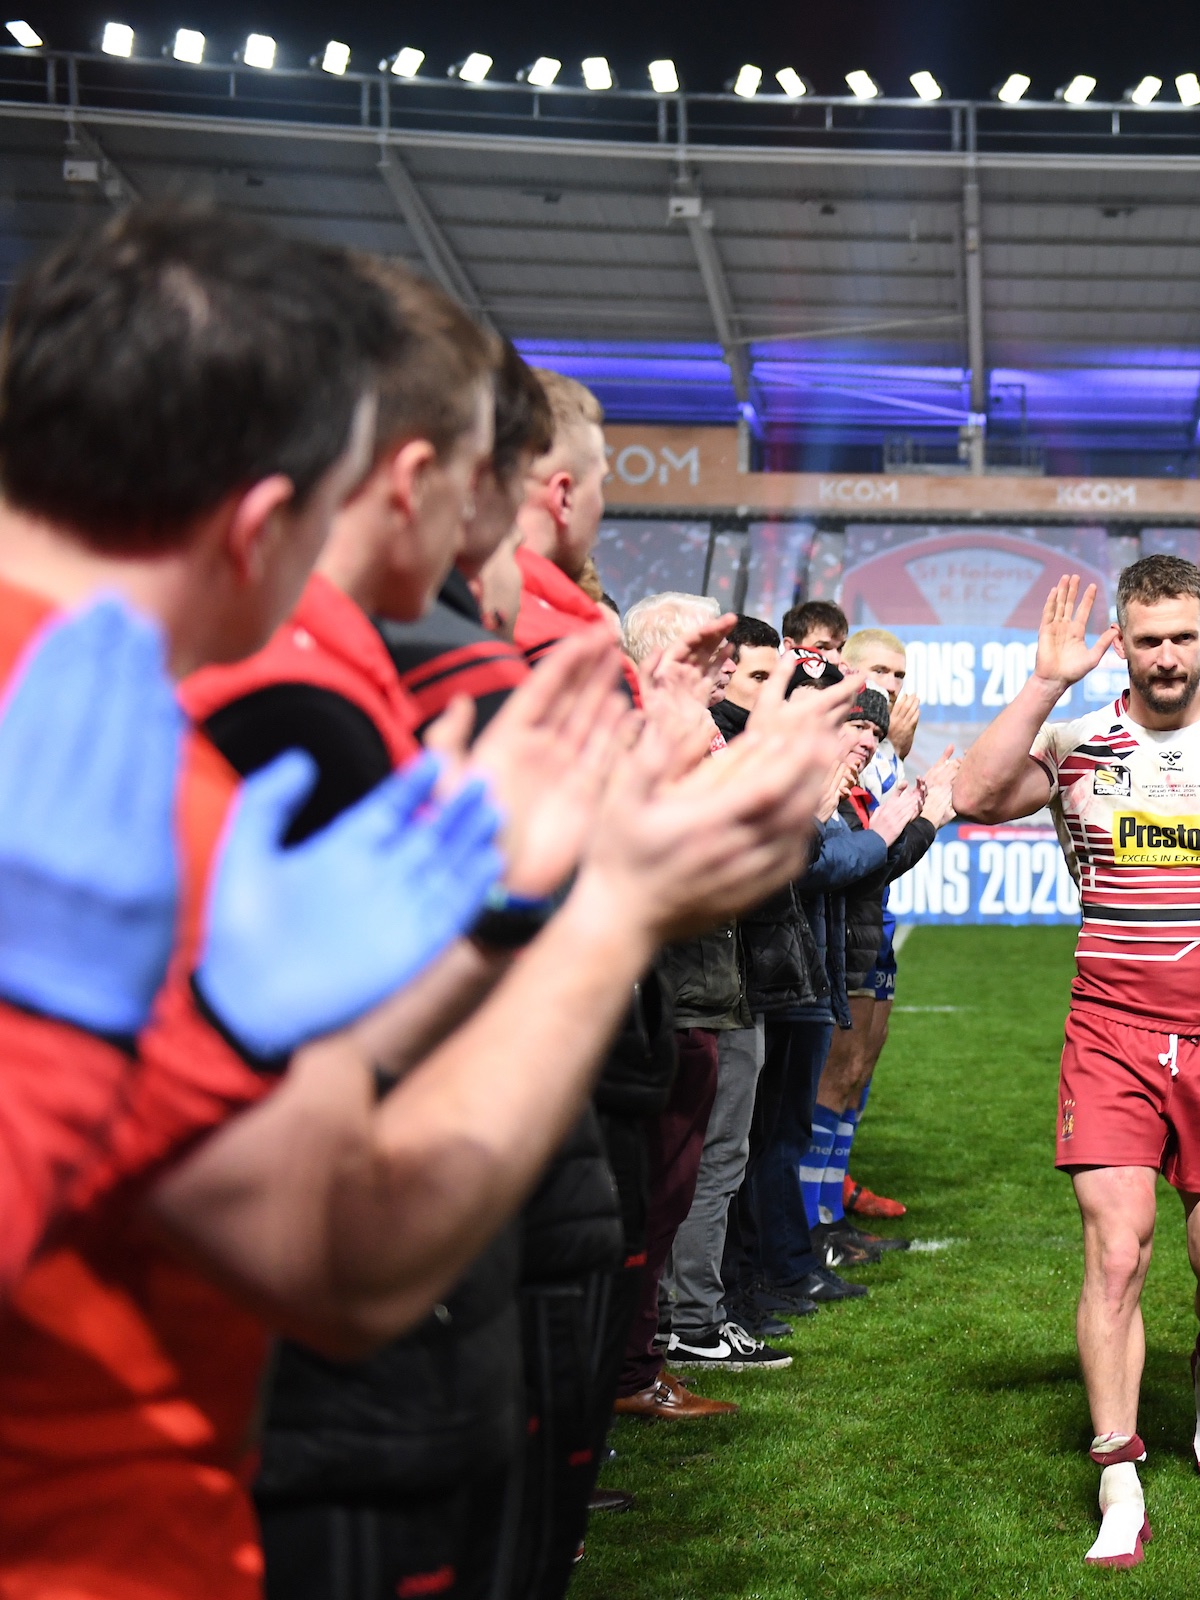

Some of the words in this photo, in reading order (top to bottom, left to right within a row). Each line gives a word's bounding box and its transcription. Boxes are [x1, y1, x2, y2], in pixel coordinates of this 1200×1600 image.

[819, 479, 898, 502] KCOM
[1057, 482, 1136, 505] KCOM
[1121, 854, 1158, 863] EXCELS
[1160, 854, 1171, 862] IN
